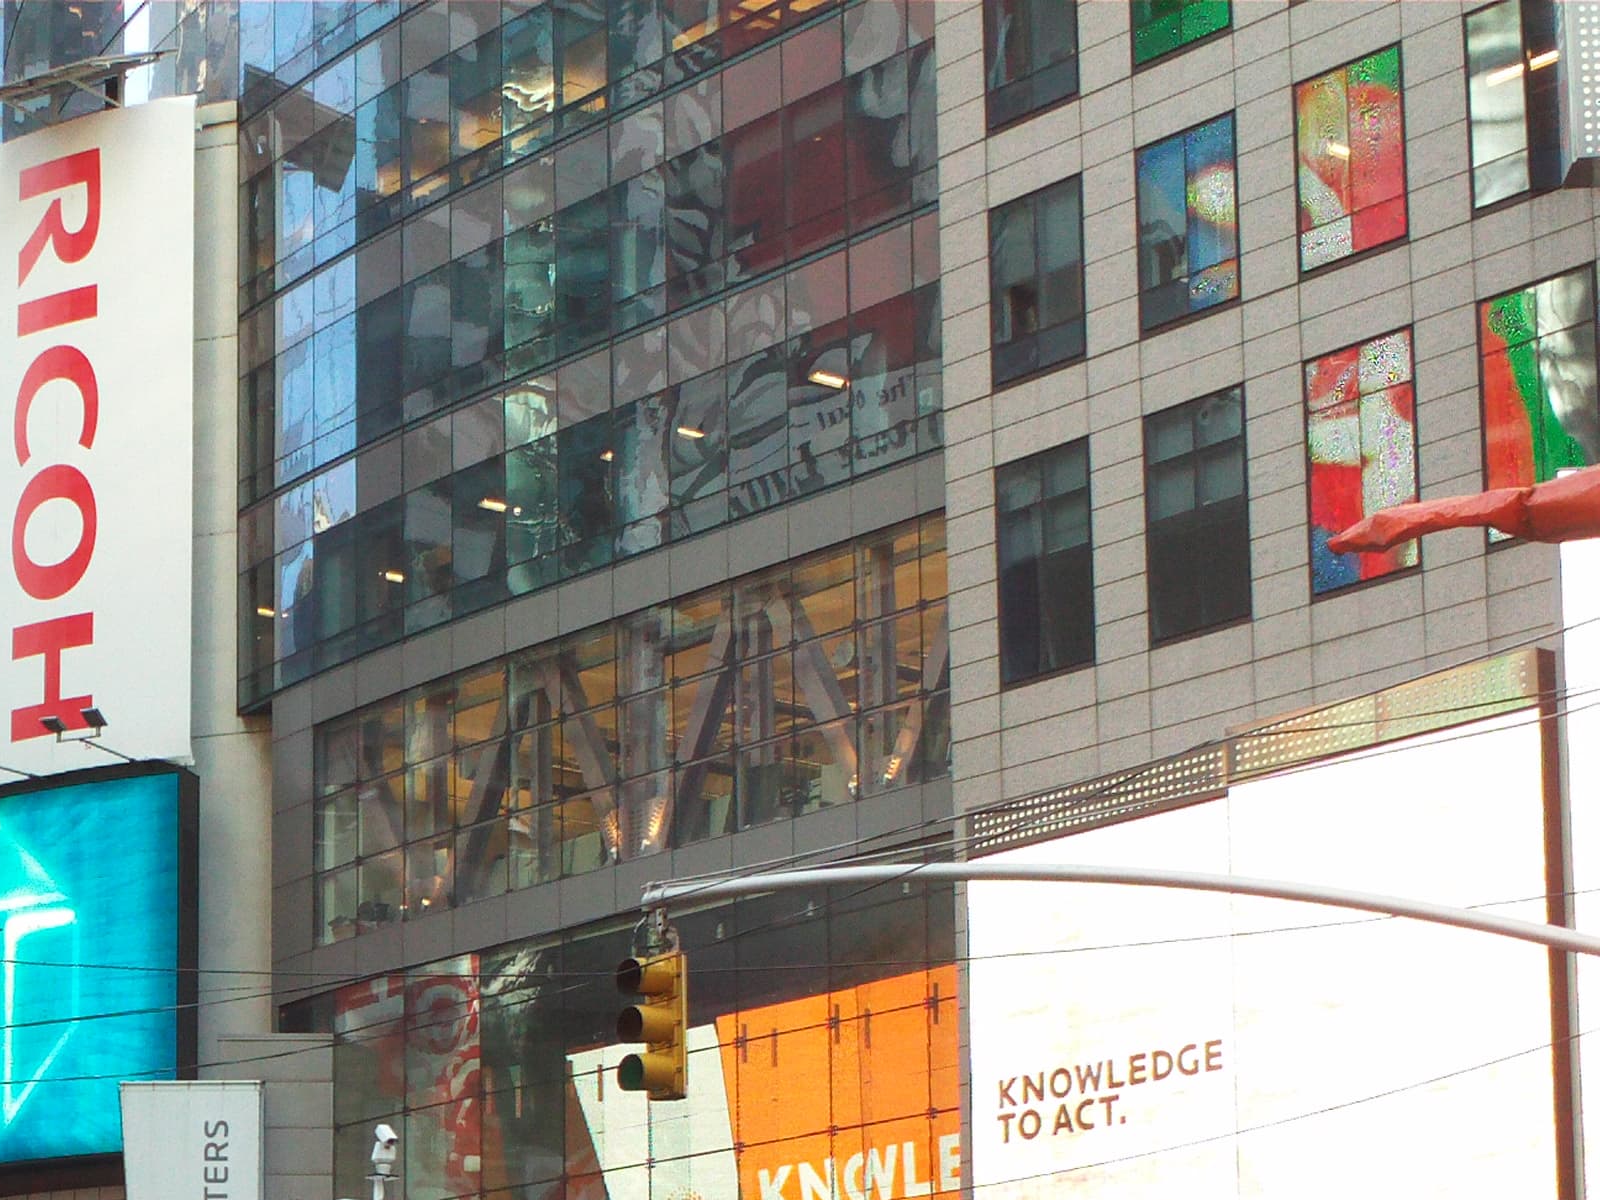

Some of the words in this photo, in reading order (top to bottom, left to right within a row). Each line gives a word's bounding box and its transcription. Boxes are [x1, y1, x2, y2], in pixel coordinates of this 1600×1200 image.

[10, 146, 103, 743] RICOH
[997, 1039, 1224, 1110] KNOWLEDGE
[997, 1109, 1041, 1144] TO
[1052, 1095, 1127, 1137] ACT.
